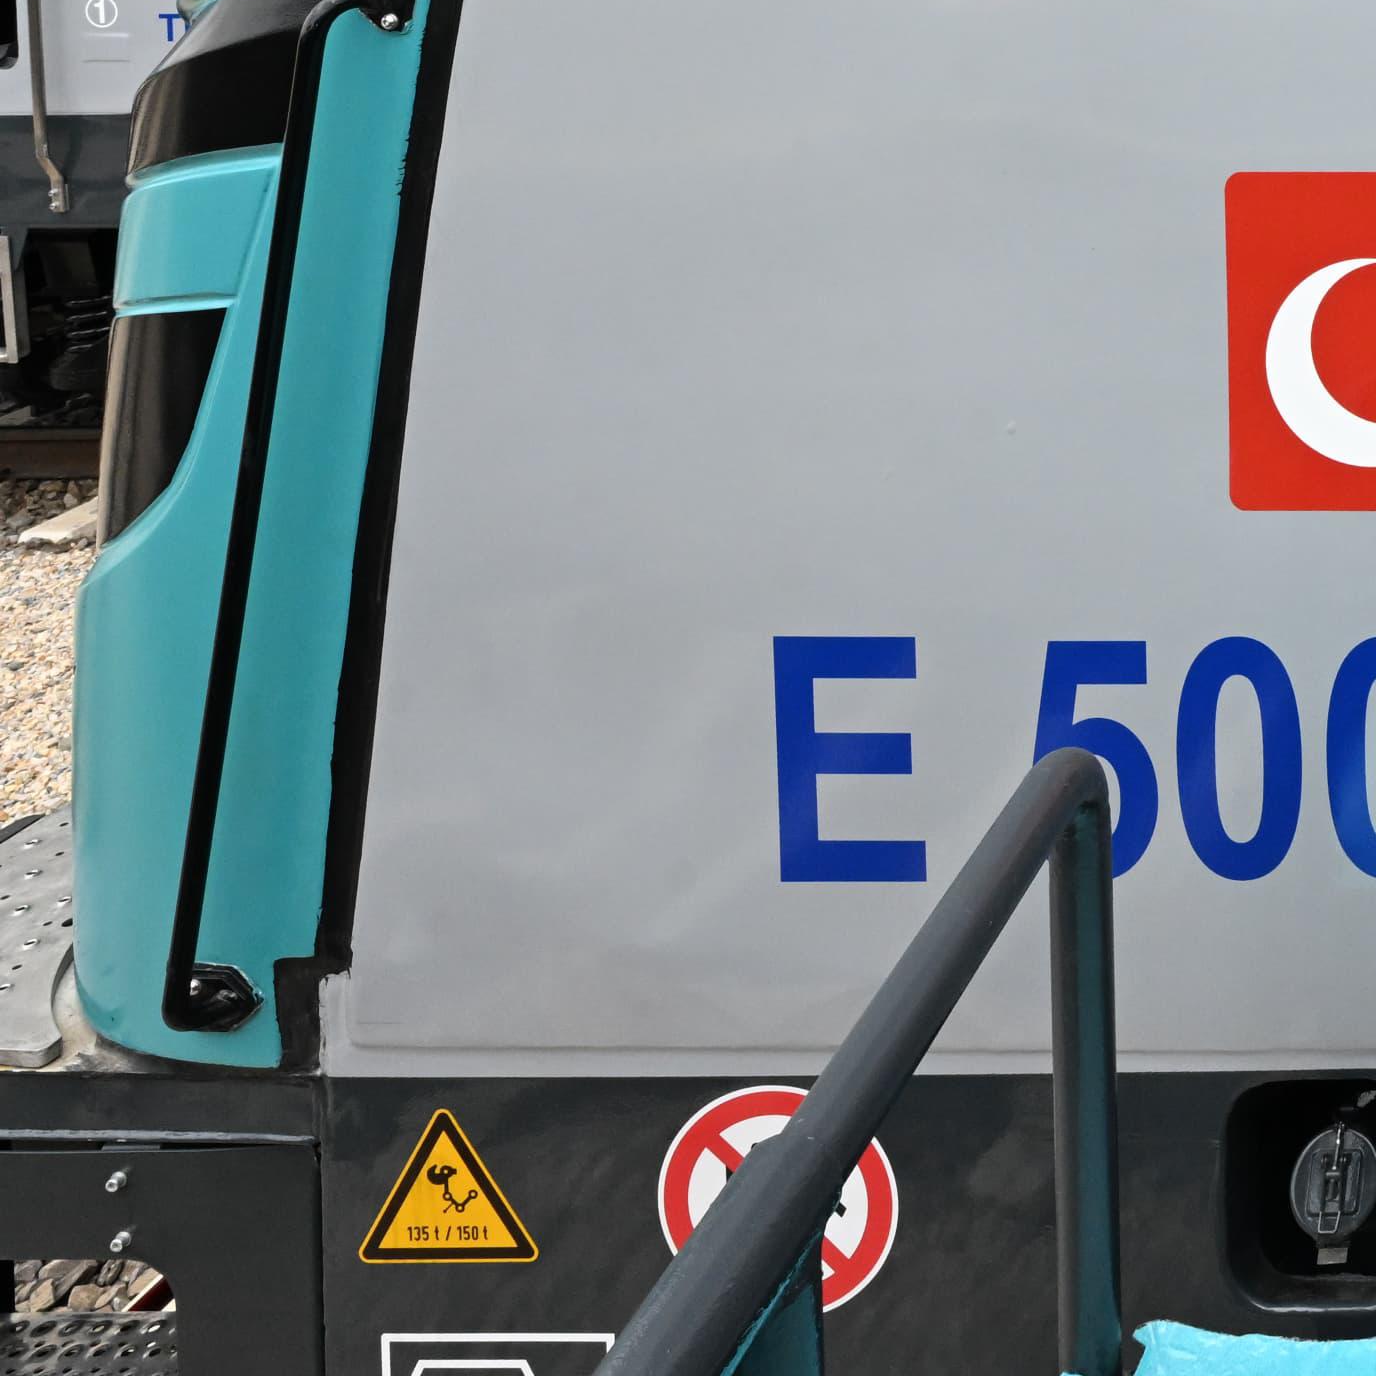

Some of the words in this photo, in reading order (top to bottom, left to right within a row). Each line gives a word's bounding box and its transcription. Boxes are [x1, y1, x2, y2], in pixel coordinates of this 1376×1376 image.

[773, 635, 927, 883] E
[407, 1225, 430, 1242] 135
[434, 1225, 440, 1241] t
[445, 1225, 452, 1241] /
[456, 1225, 479, 1241] 150
[482, 1225, 489, 1241] t
